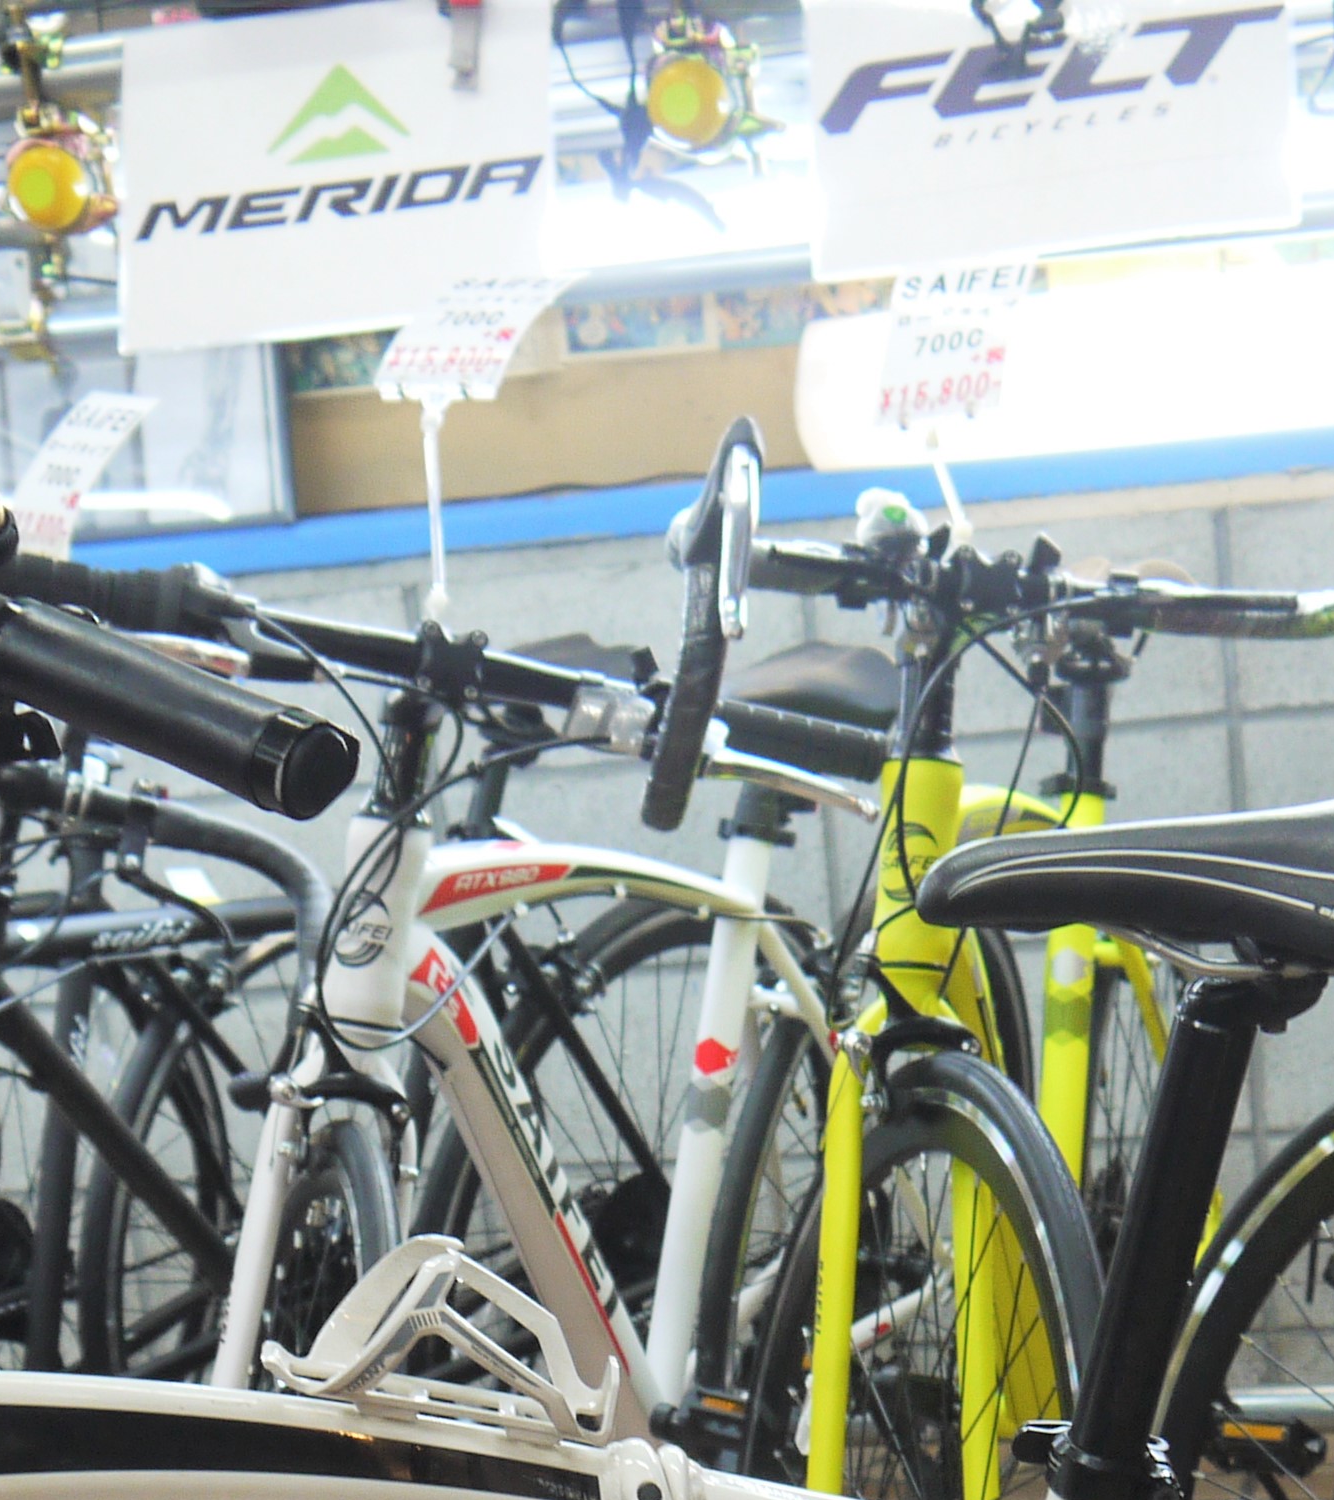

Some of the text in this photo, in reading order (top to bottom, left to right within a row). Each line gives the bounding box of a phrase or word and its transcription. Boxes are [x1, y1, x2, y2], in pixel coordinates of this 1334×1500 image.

[819, 5, 1285, 134] FELT
[933, 104, 1171, 148] BICYCLES
[134, 154, 545, 241] MERIDA
[900, 264, 1028, 300] SAIFEI
